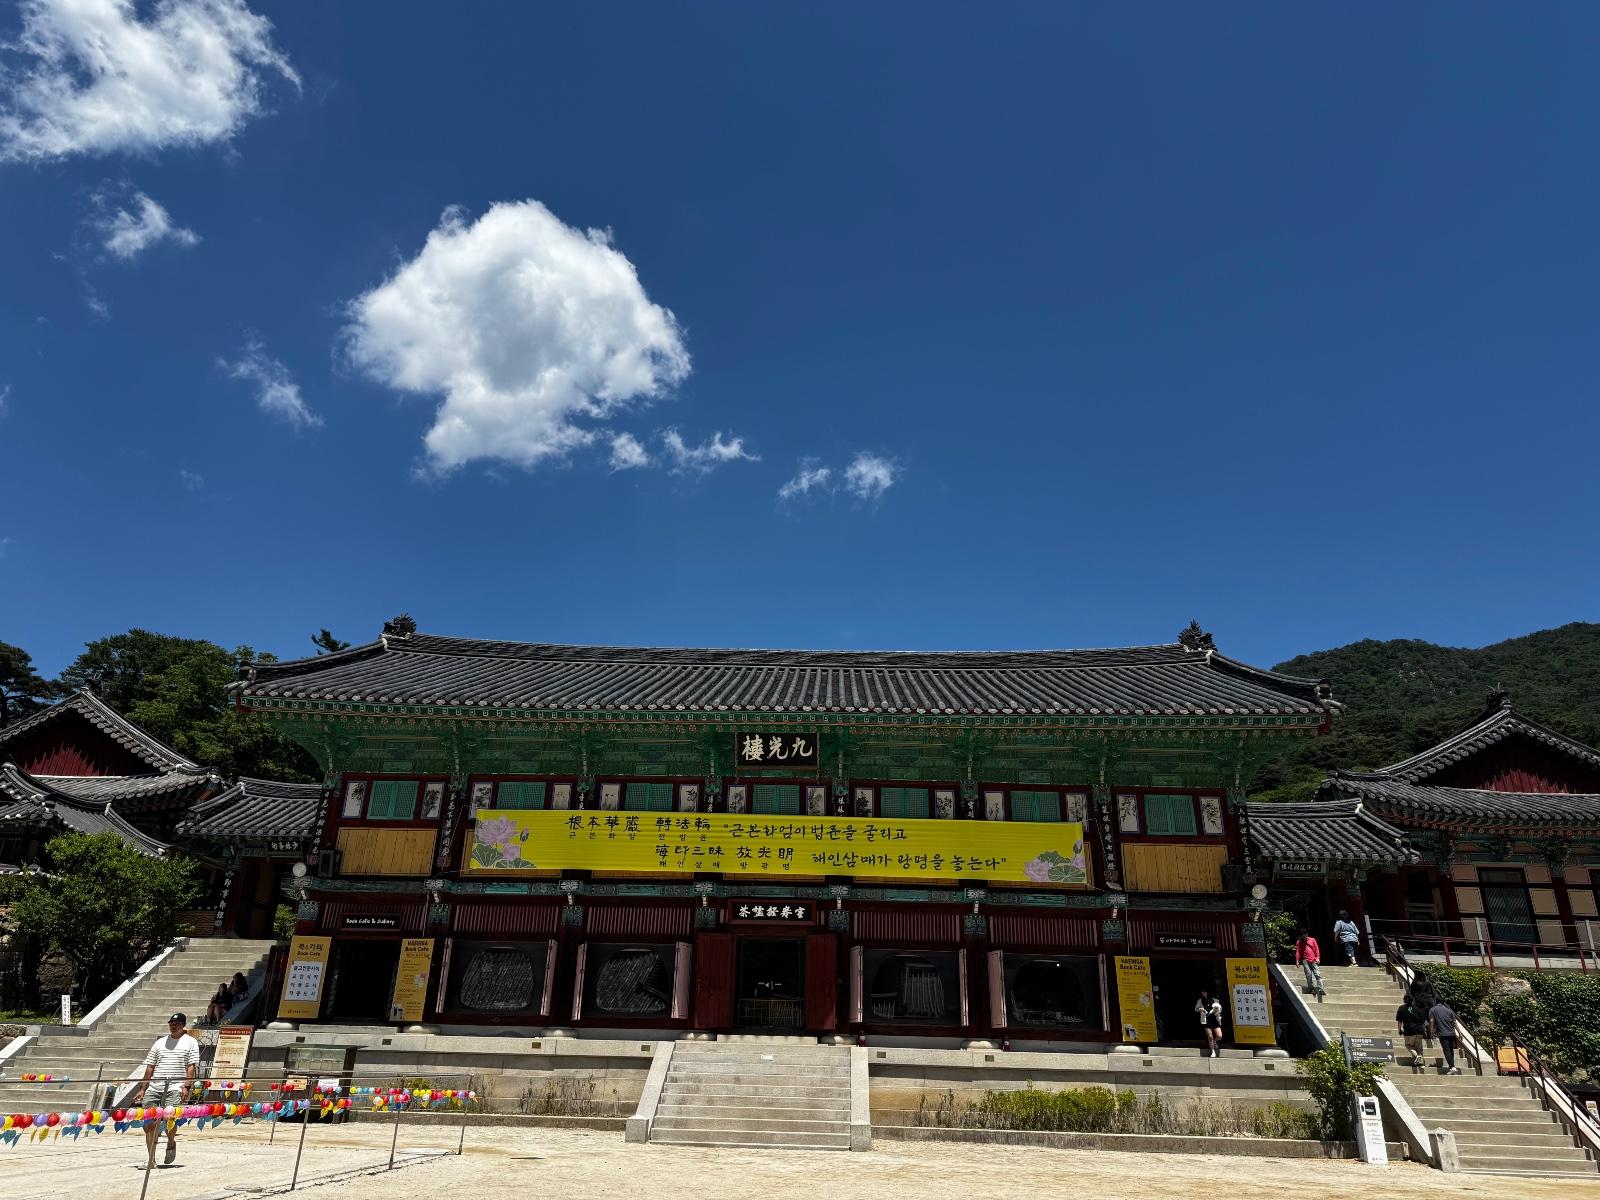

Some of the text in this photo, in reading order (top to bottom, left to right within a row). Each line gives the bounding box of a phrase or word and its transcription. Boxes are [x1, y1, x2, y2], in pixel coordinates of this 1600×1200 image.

[655, 816, 711, 833] 轉法輪
[811, 823, 857, 842] 법륜을
[862, 824, 908, 842] 굴리고
[655, 843, 794, 861] 海印三昧 放光明
[811, 850, 892, 869] 해인삼매가
